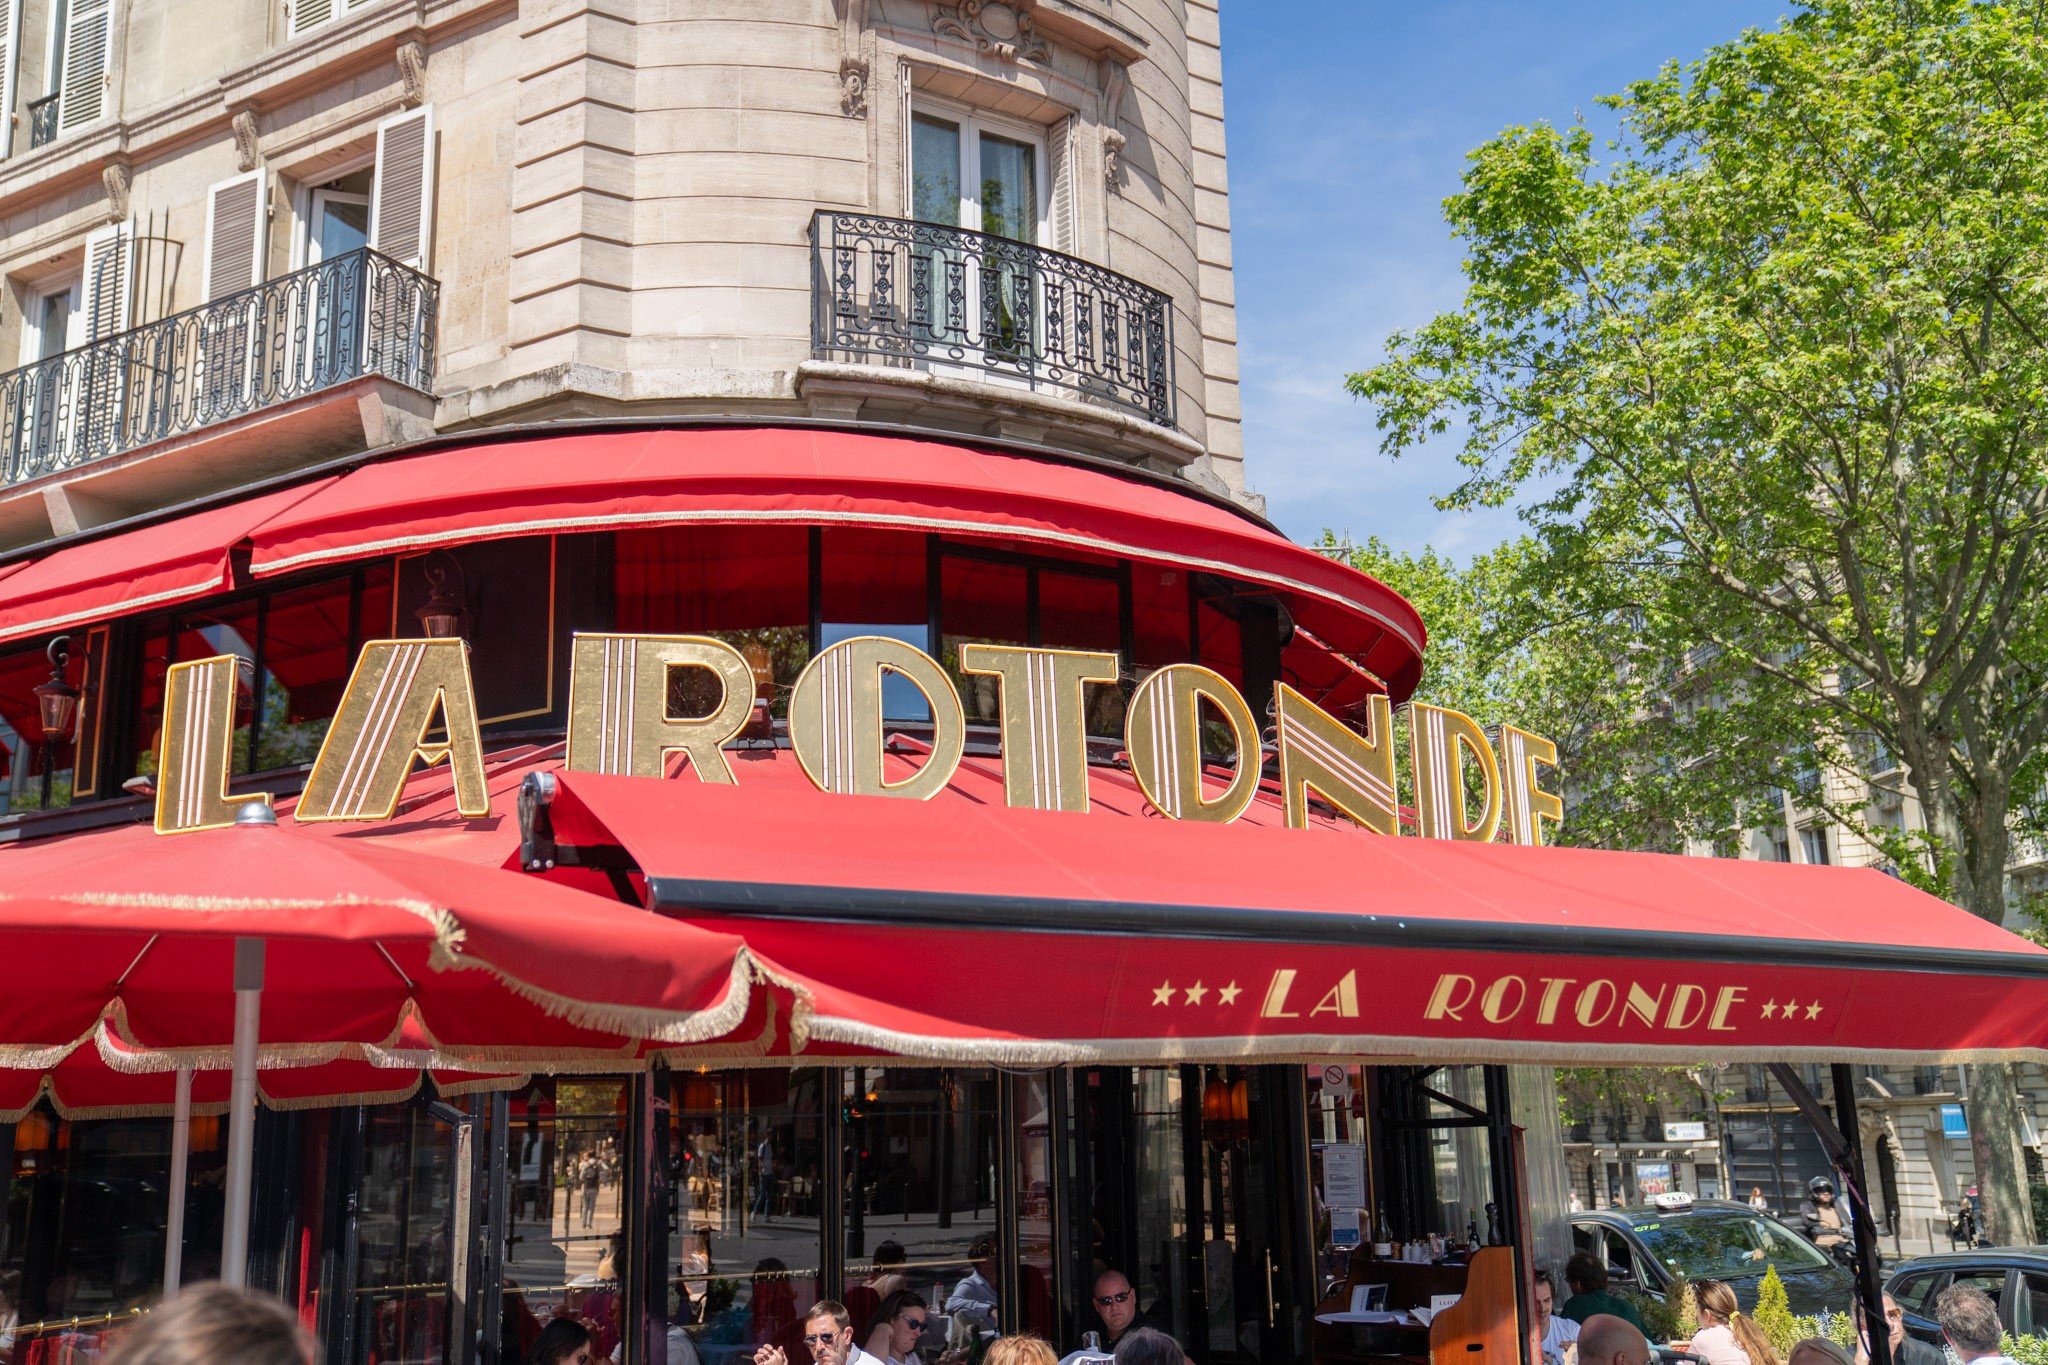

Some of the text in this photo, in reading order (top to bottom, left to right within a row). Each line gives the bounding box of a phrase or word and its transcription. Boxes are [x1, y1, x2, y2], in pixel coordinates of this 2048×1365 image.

[154, 632, 1563, 849] LA ROTONDE
[1260, 968, 1749, 1031] LA ROTONDE
[1666, 1194, 1687, 1203] TAXI
